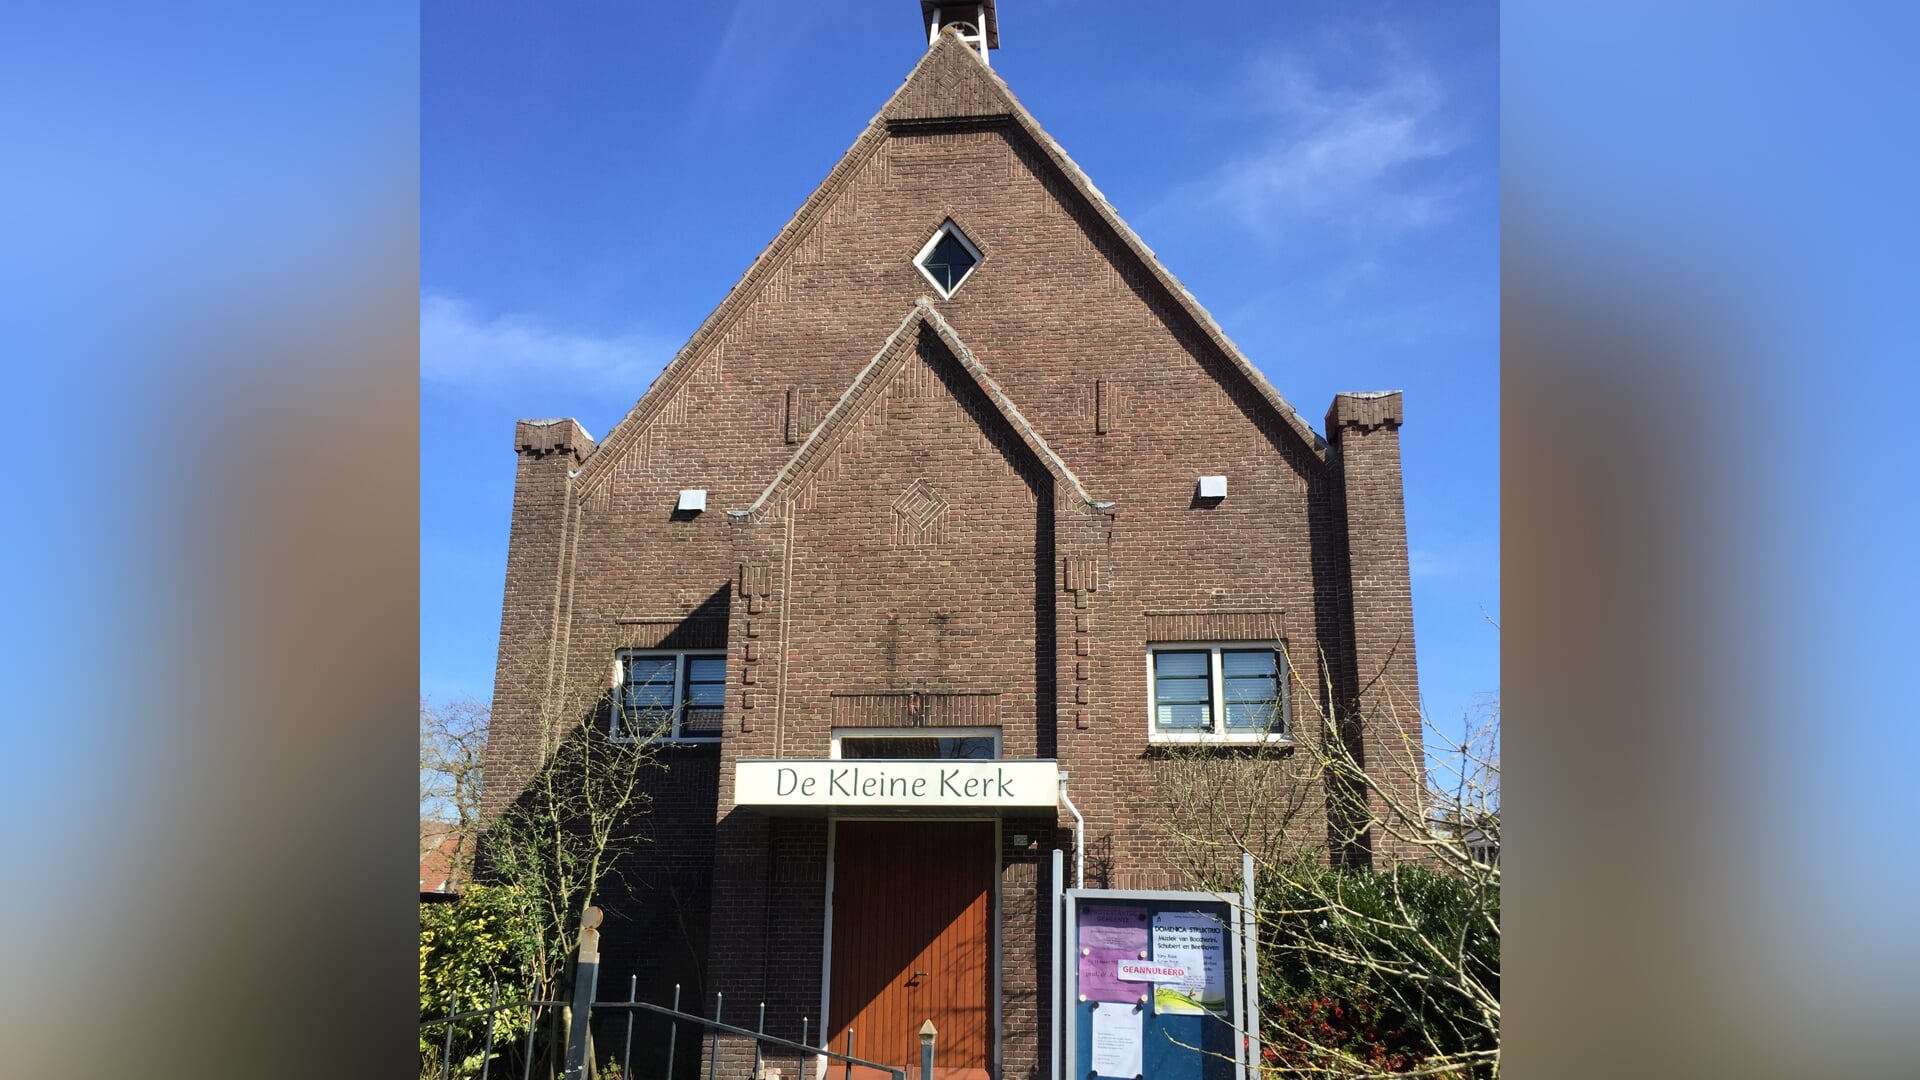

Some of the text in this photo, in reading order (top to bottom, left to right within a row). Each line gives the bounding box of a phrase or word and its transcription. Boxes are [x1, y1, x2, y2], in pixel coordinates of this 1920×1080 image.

[776, 767, 1015, 798] De Kleine Kerk
[1154, 925, 1187, 933] DOMENICA
[1122, 965, 1184, 977] GEANNULEERD
